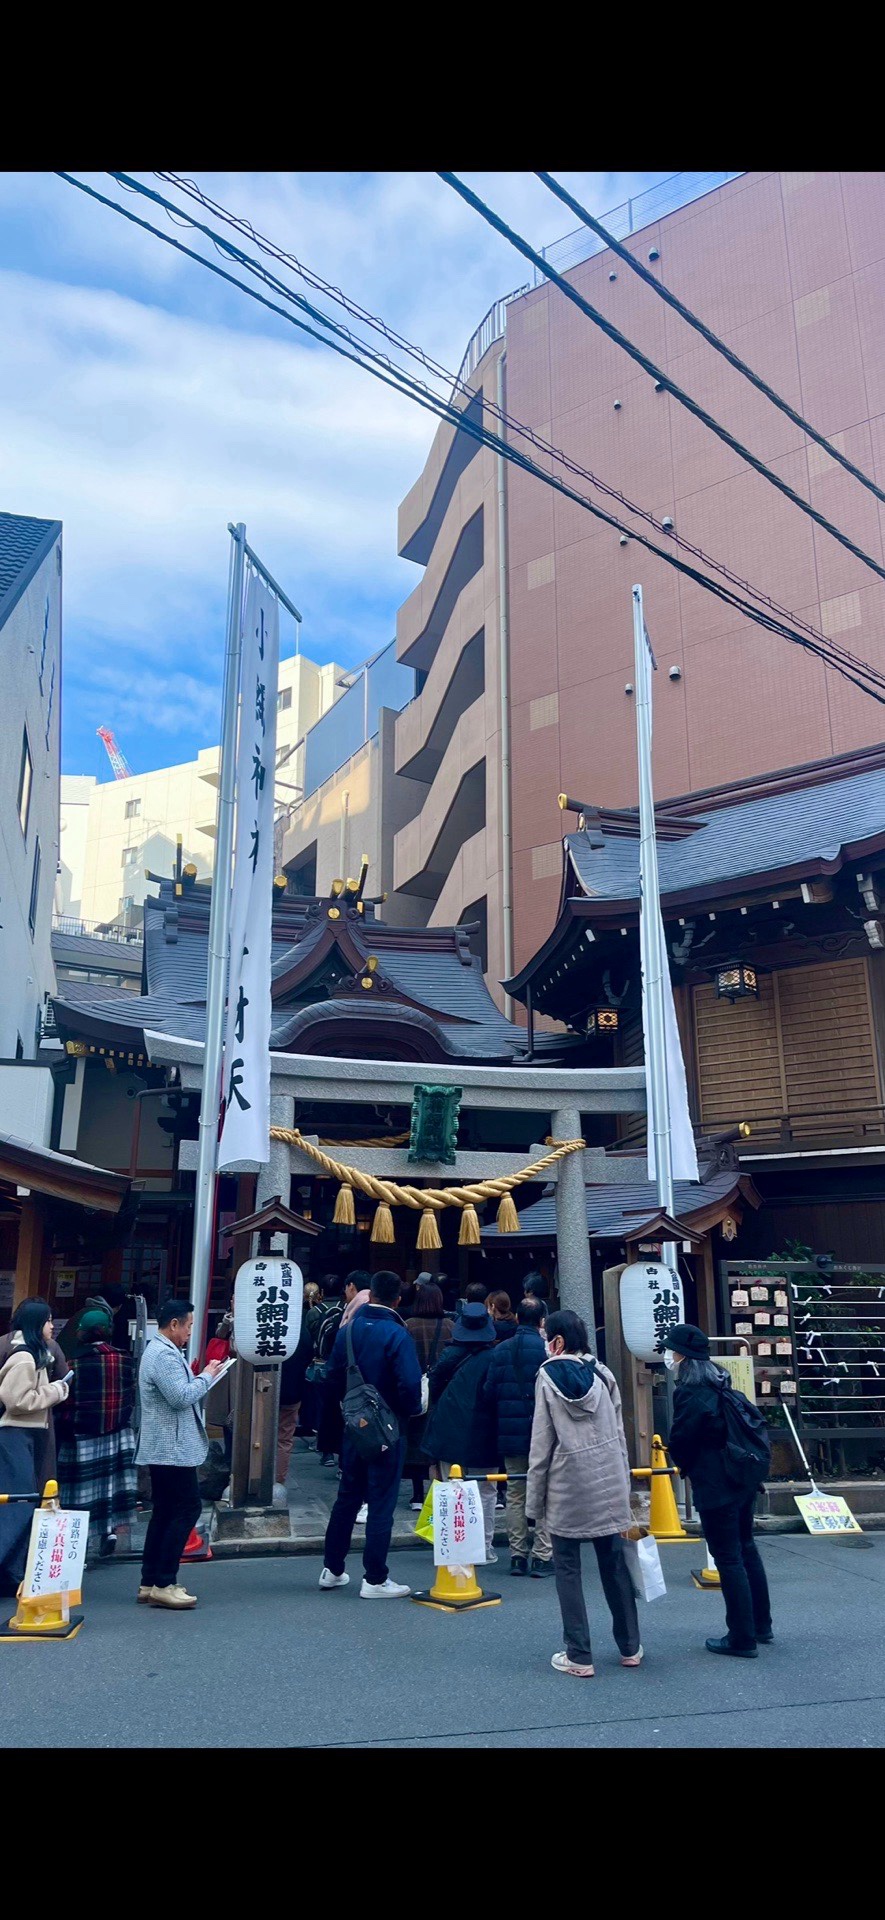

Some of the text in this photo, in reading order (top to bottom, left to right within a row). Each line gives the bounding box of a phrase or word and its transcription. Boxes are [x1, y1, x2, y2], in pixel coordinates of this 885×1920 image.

[255, 1286, 289, 1357] 小網神社
[67, 1518, 81, 1560] 道路での
[453, 1487, 465, 1543] 写真撮影
[48, 1517, 68, 1579] 写真撮影
